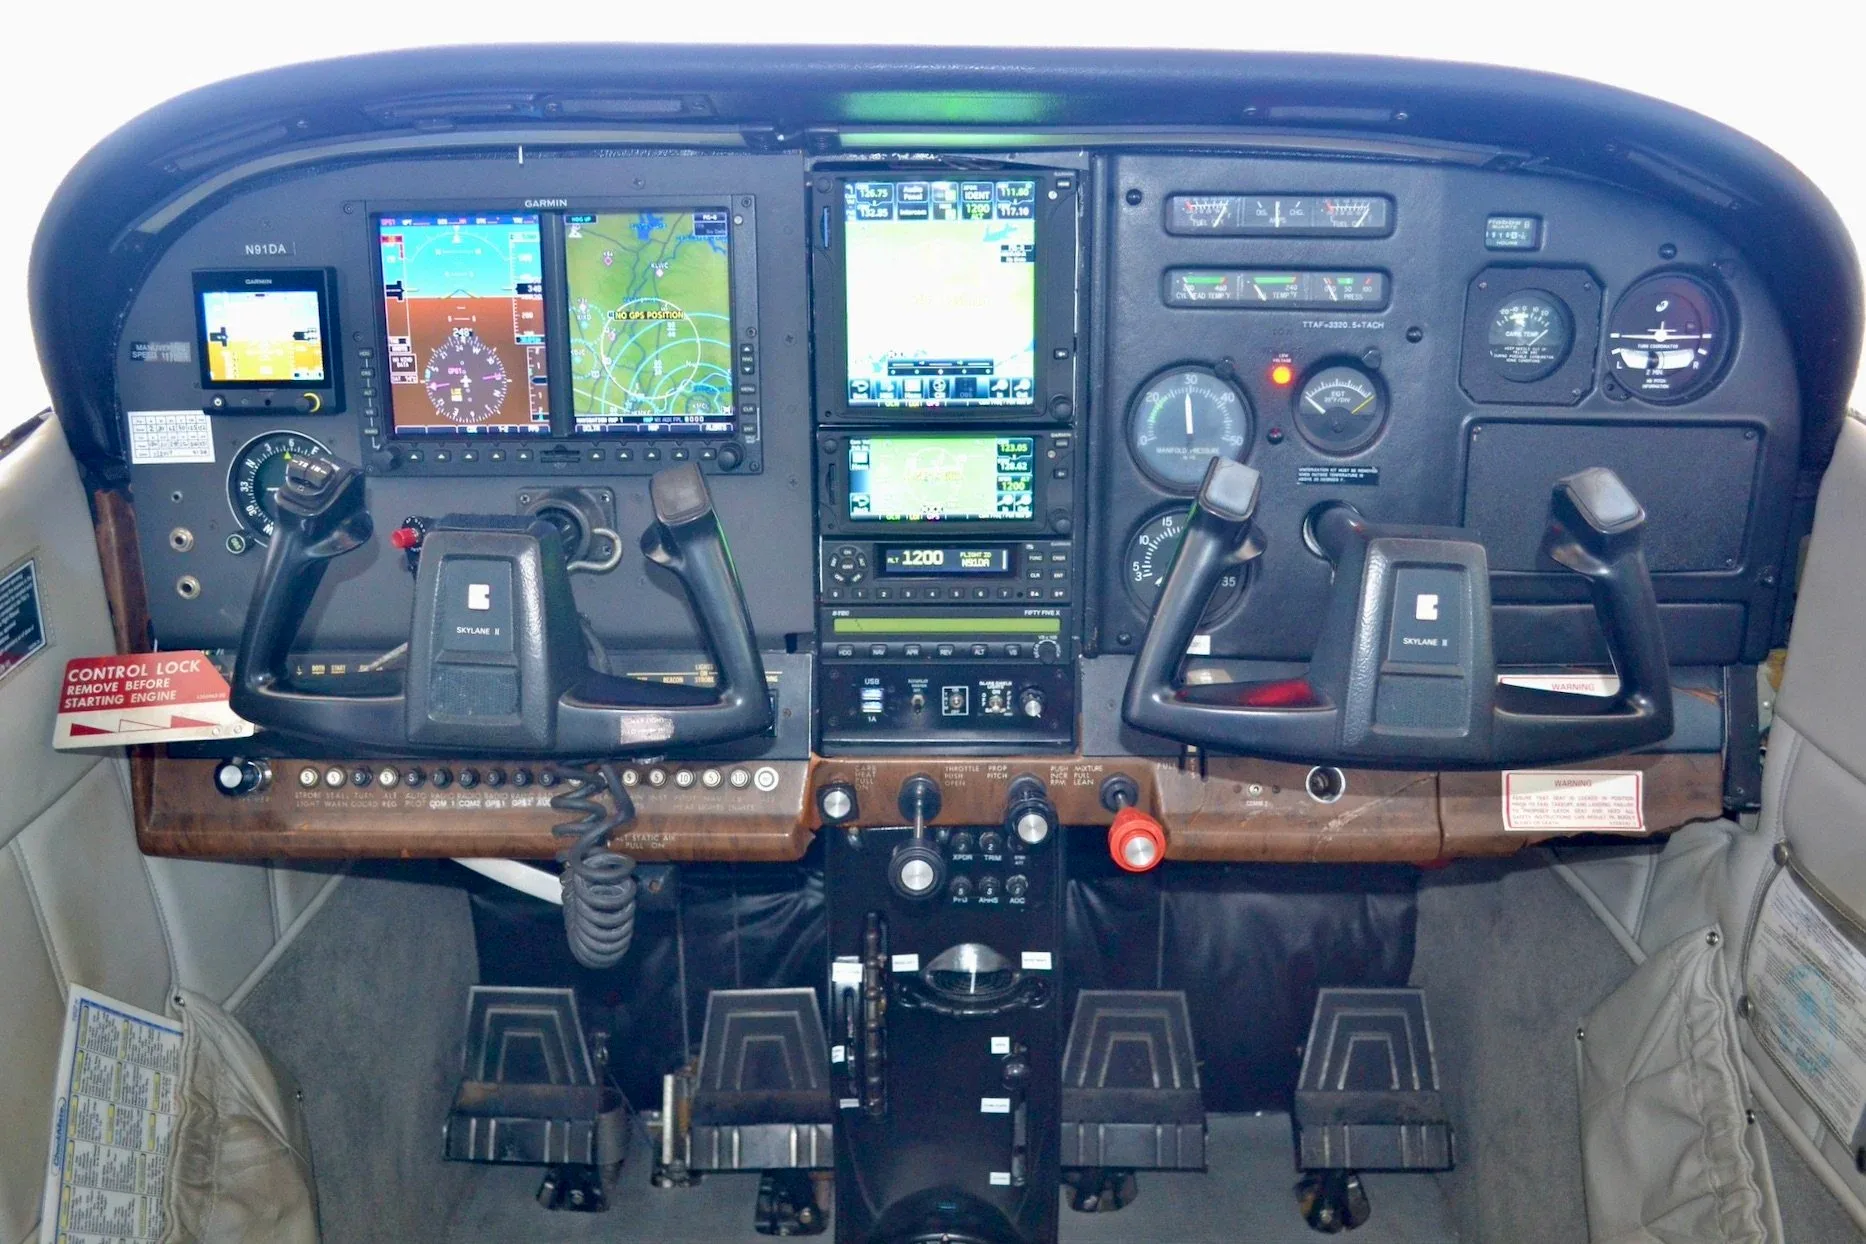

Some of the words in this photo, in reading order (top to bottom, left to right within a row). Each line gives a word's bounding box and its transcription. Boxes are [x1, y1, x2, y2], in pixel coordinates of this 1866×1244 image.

[965, 192, 990, 200] IDENT
[525, 199, 567, 207] GARMIN
[966, 204, 990, 213] 1200
[245, 244, 286, 255] N91DA
[1616, 361, 1622, 369] L
[1692, 361, 1699, 369] R
[1184, 374, 1198, 384] 30
[1146, 392, 1160, 402] 20
[1220, 392, 1234, 402] 40
[288, 438, 295, 447] 6
[1230, 436, 1244, 446] 50
[264, 443, 272, 452] 3
[245, 458, 256, 469] N
[240, 481, 249, 492] 33
[1002, 482, 1026, 490] 1200
[245, 505, 257, 517] 30
[1162, 516, 1172, 526] 15
[1138, 536, 1150, 544] 10
[902, 550, 944, 566] 1200
[1132, 562, 1140, 570] 5
[1135, 572, 1142, 581] 3
[1222, 577, 1236, 587] 35
[456, 627, 490, 636] SKYLANE
[1402, 638, 1438, 646] SKYLANE
[68, 664, 148, 682] CONTROL
[156, 660, 200, 674] LOCK
[67, 682, 118, 696] REMOVE
[125, 678, 170, 692] BEFORE
[1551, 682, 1595, 692] WARNING
[64, 694, 124, 708] STARTING
[131, 690, 176, 704] ENGINE
[304, 773, 310, 782] 5
[354, 773, 361, 782] 5
[384, 773, 390, 782] 5
[408, 773, 415, 782] 5
[516, 773, 522, 782] 5
[544, 773, 550, 782] 5
[626, 773, 632, 782] 5
[654, 773, 660, 782] 5
[679, 773, 690, 782] 10
[708, 773, 714, 782] 5
[734, 773, 744, 782] 10
